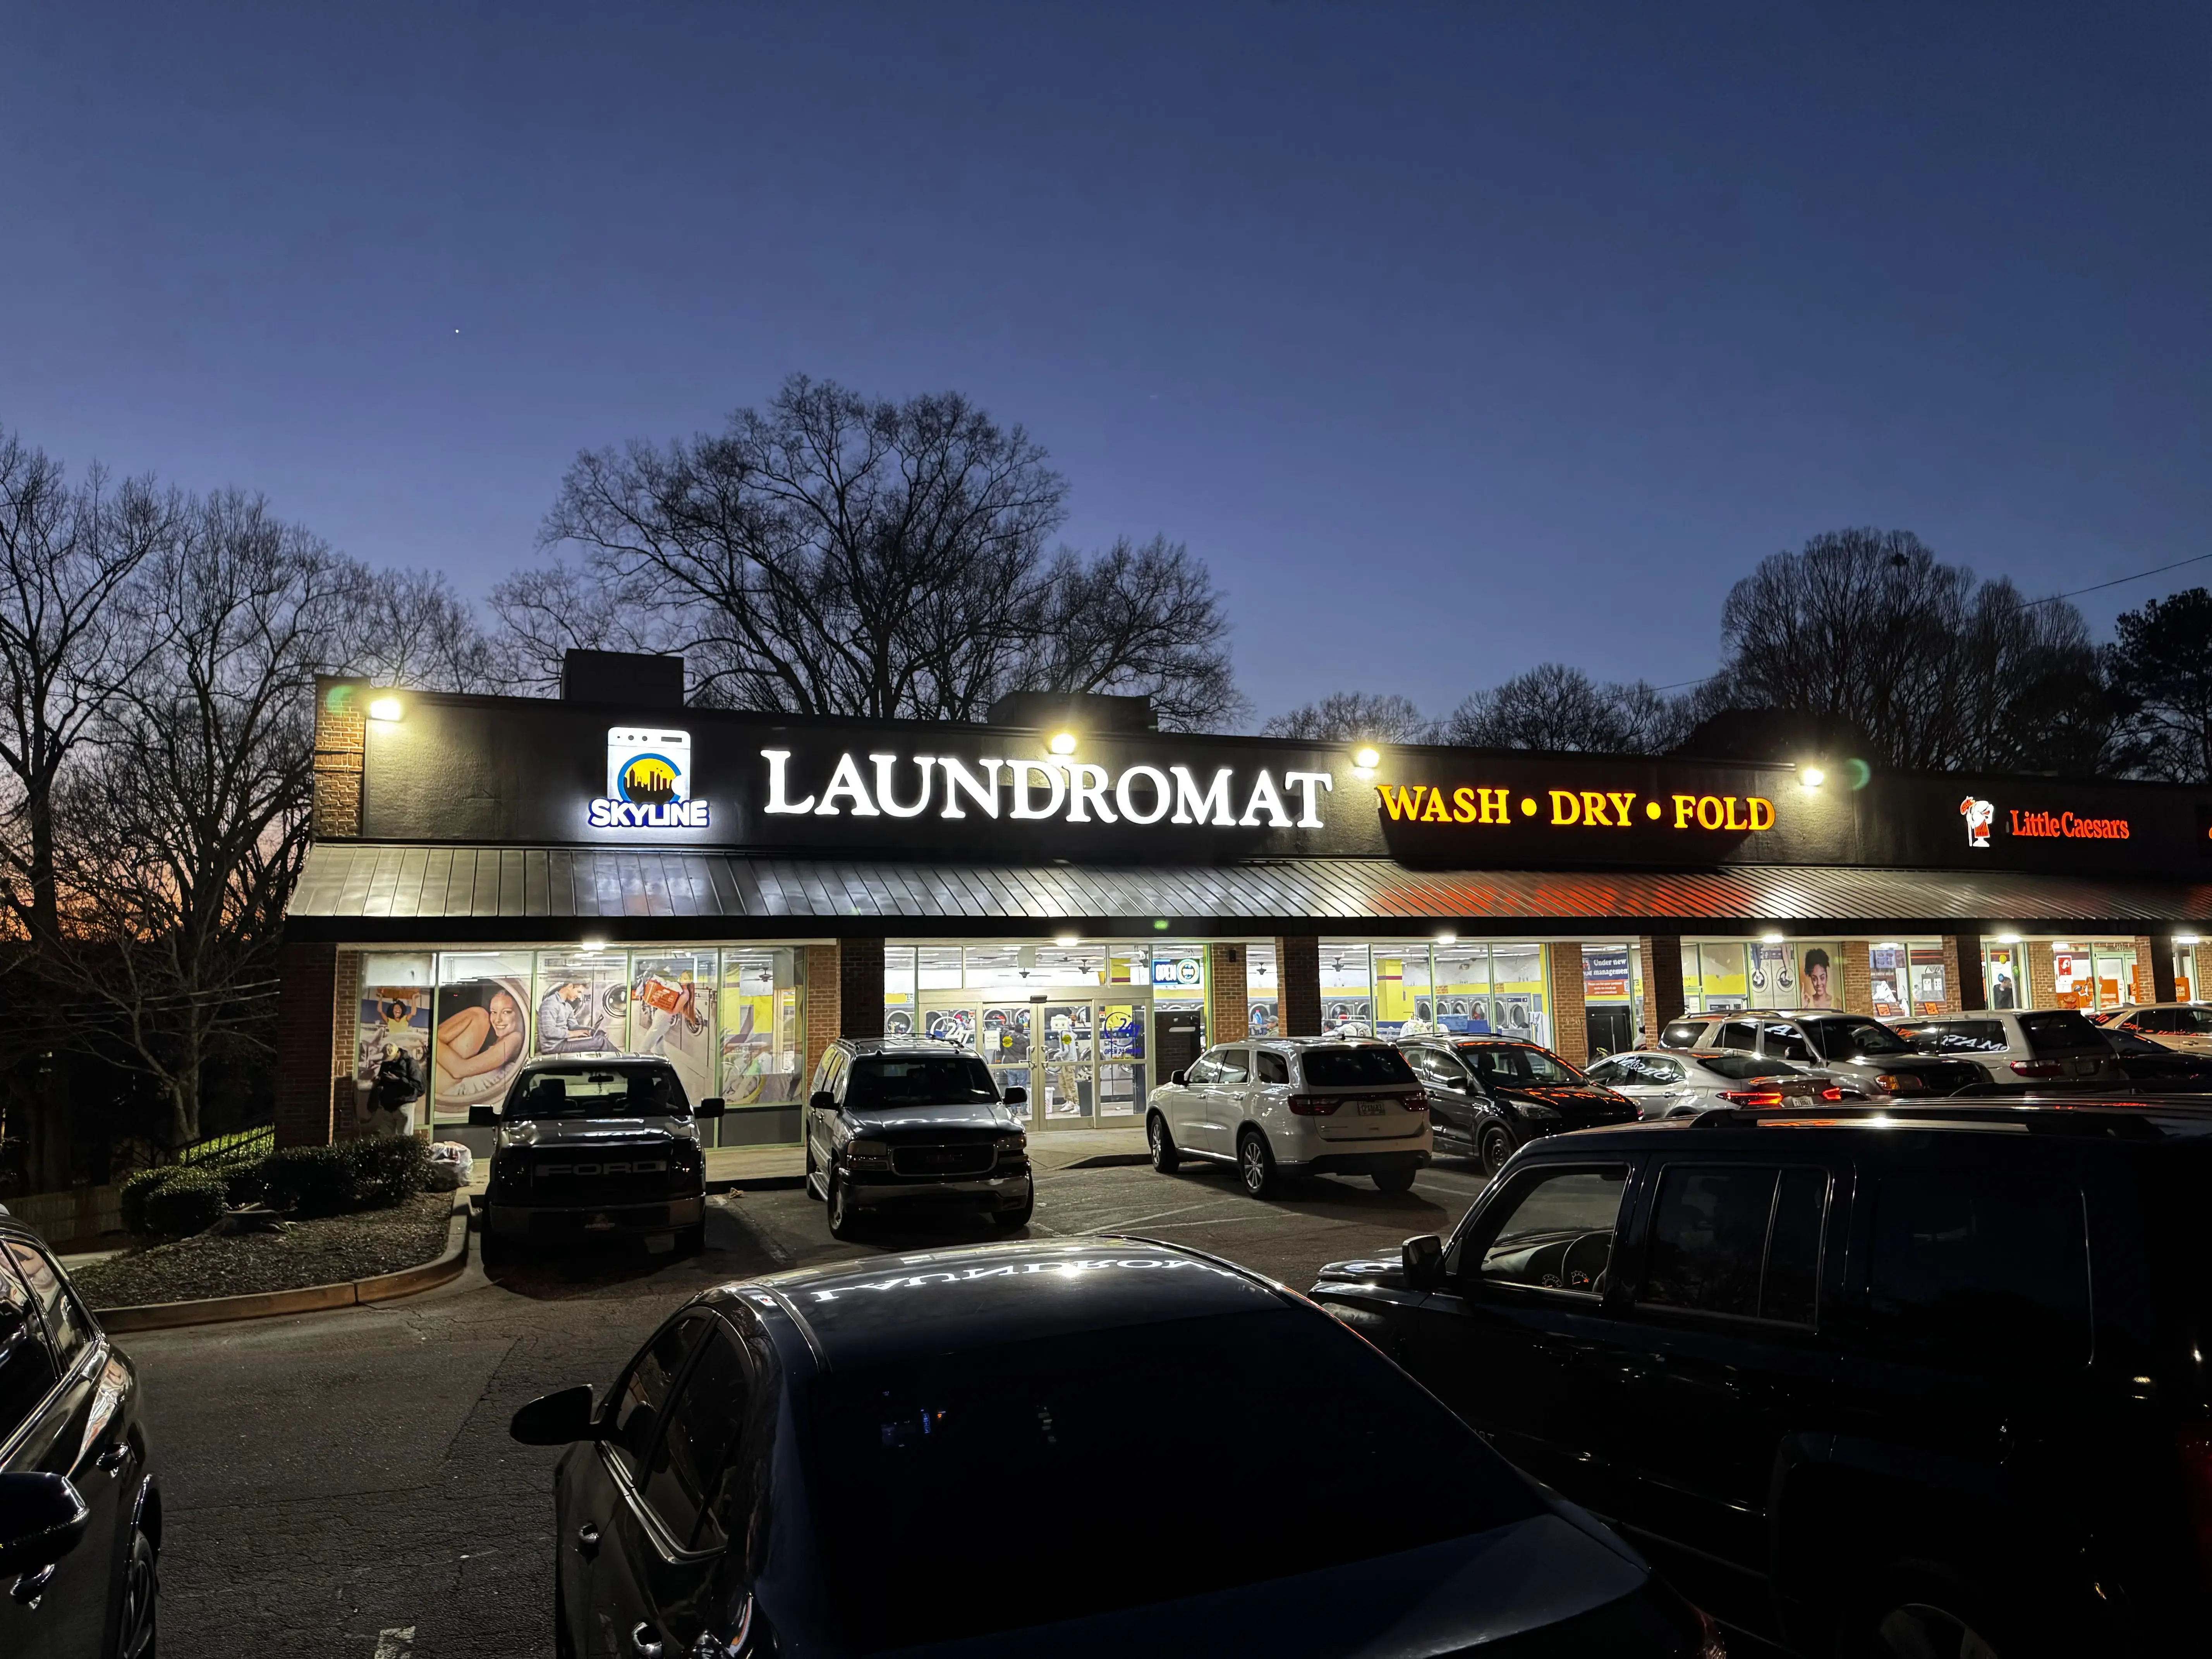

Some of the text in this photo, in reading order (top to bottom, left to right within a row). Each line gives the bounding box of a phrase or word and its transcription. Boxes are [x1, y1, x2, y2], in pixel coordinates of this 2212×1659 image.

[760, 750, 1333, 828] LAUNDROMAT
[589, 799, 709, 827] SKYLINE
[1377, 784, 1775, 831] WASH DRY FOLD
[2010, 810, 2129, 839] Little Caesars
[1155, 964, 1176, 981] OPEN
[1593, 968, 1628, 976] managemen
[535, 1160, 666, 1176] FORD
